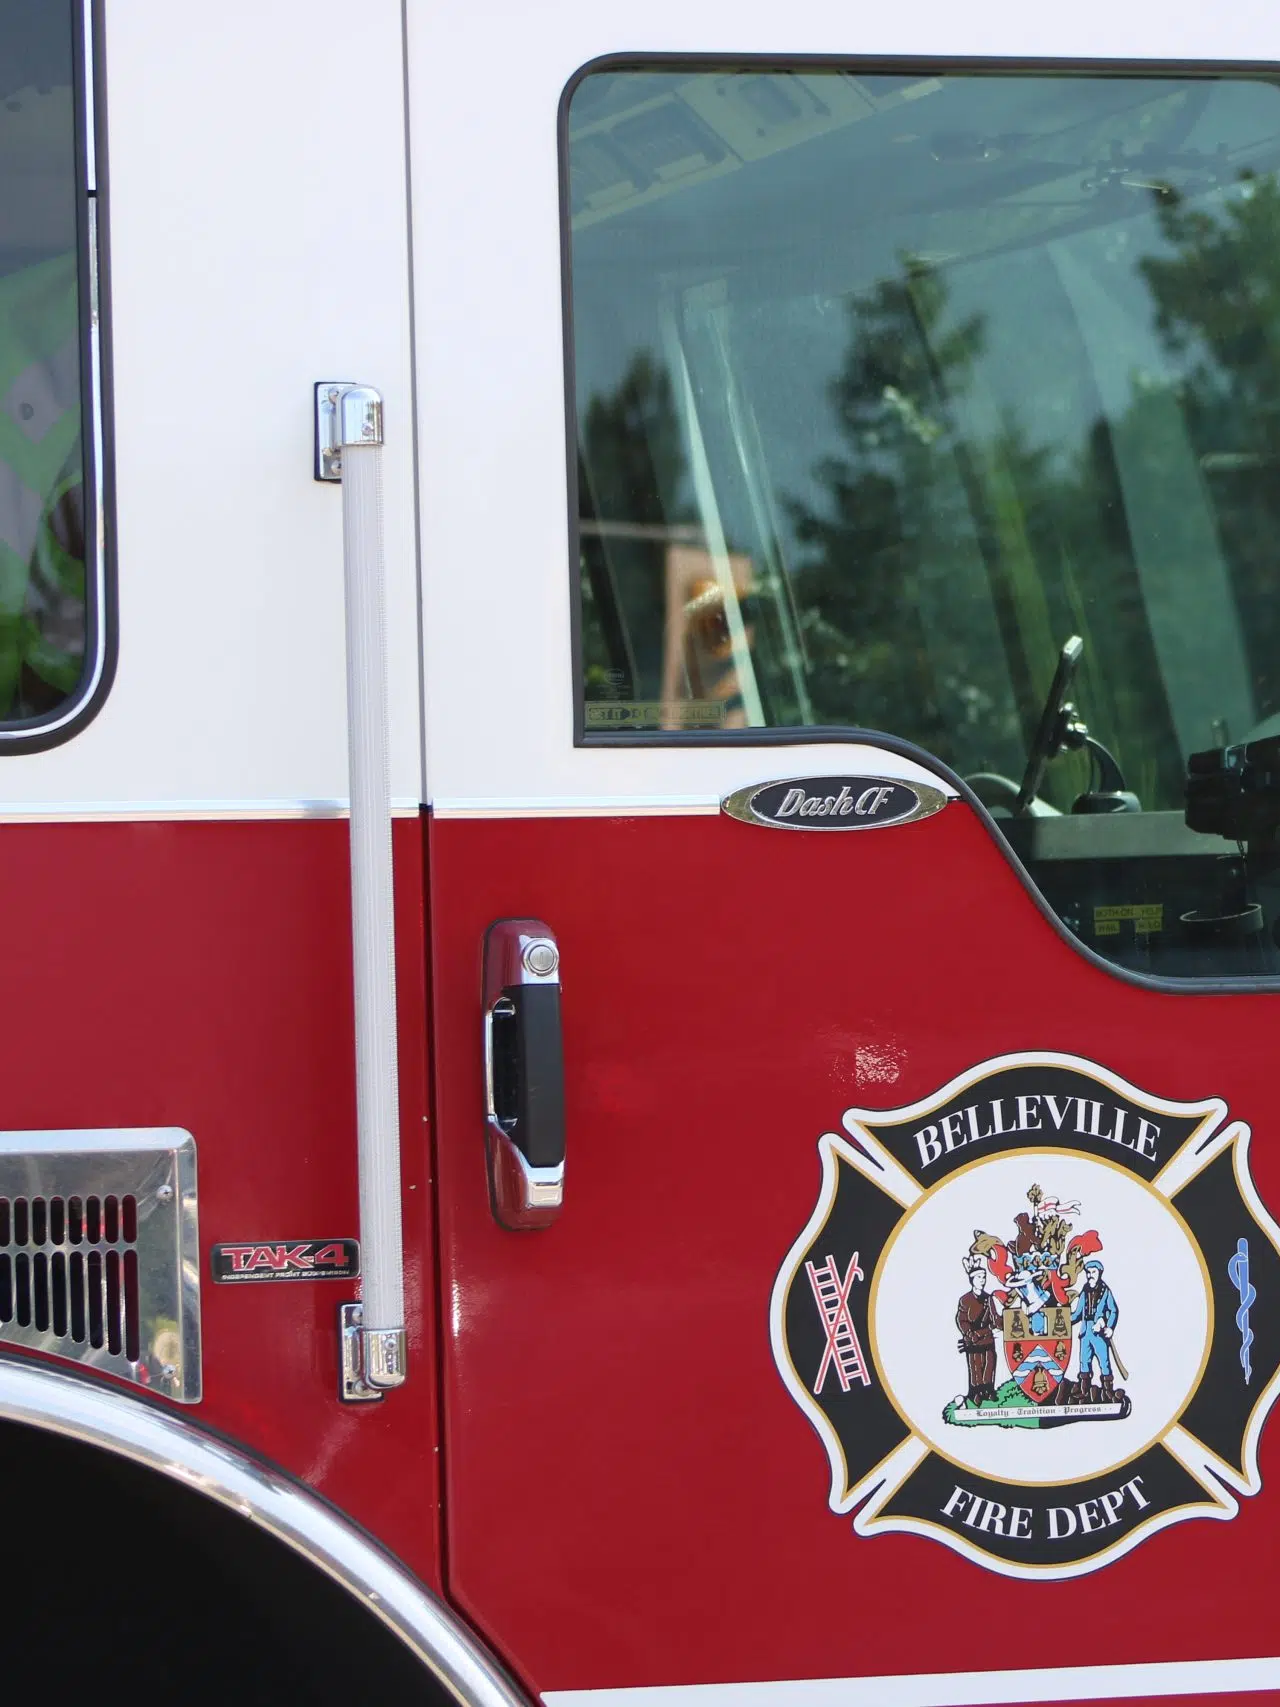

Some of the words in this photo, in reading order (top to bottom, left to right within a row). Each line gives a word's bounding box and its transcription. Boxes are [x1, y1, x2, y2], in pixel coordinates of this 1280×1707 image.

[775, 786, 854, 818] Dash
[854, 786, 895, 816] CF
[913, 1094, 1162, 1169] BELLEVILLE
[220, 1243, 350, 1272] TAK-4
[976, 1409, 1009, 1418] Loyalty
[1016, 1407, 1056, 1416] Tradition
[1063, 1405, 1101, 1415] Progress
[940, 1484, 1032, 1539] FIRE
[1046, 1475, 1151, 1539] DEPT
